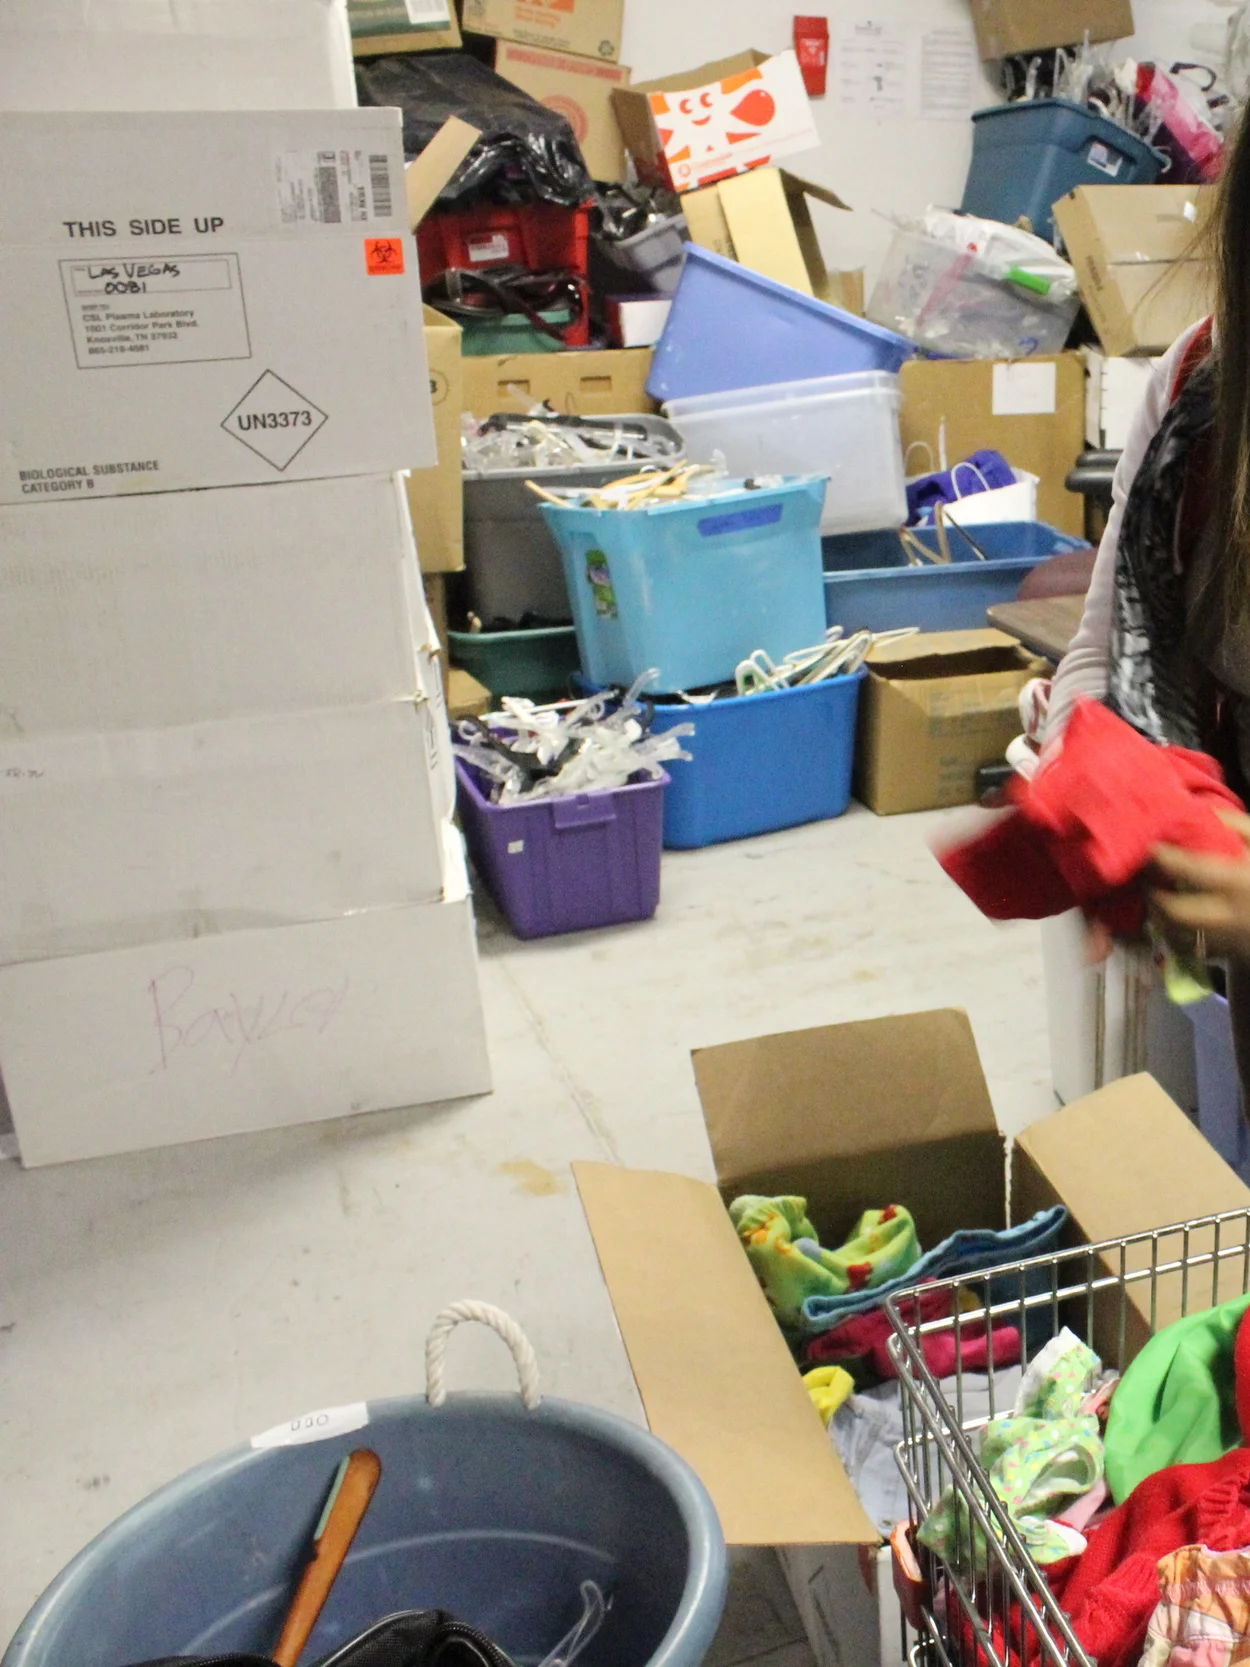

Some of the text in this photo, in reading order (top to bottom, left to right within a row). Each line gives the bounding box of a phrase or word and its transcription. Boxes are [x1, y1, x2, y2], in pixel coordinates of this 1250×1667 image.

[63, 216, 224, 238] THIS SIDE UP
[87, 262, 181, 280] LAS VEGAS
[105, 311, 141, 321] Plasma
[143, 309, 195, 320] Laboratory
[152, 321, 173, 330] Park
[135, 332, 149, 342] TN
[237, 410, 312, 431] UN3373
[19, 459, 160, 482] BIOLOGICAL SUBSTANCE
[21, 478, 95, 494] CATEGORY B
